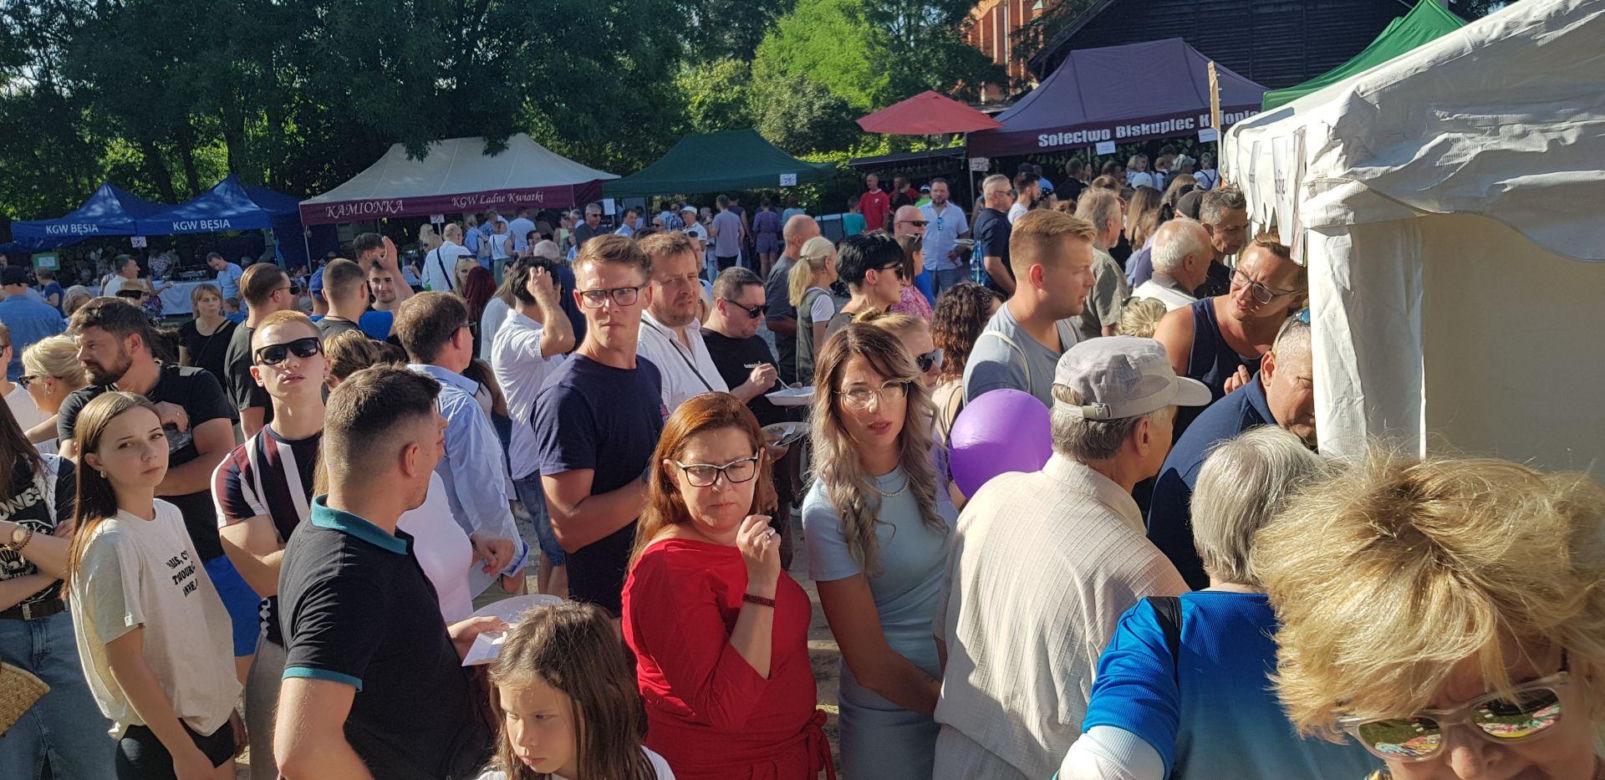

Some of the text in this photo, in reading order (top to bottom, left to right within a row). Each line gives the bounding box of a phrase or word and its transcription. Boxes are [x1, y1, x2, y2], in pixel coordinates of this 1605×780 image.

[1038, 110, 1259, 147] Sołectwo Biskupiec Kloni
[325, 199, 404, 219] KAMIONKA
[45, 223, 99, 235] KGW BĘSIA
[172, 218, 231, 232] KGW BĘSIA
